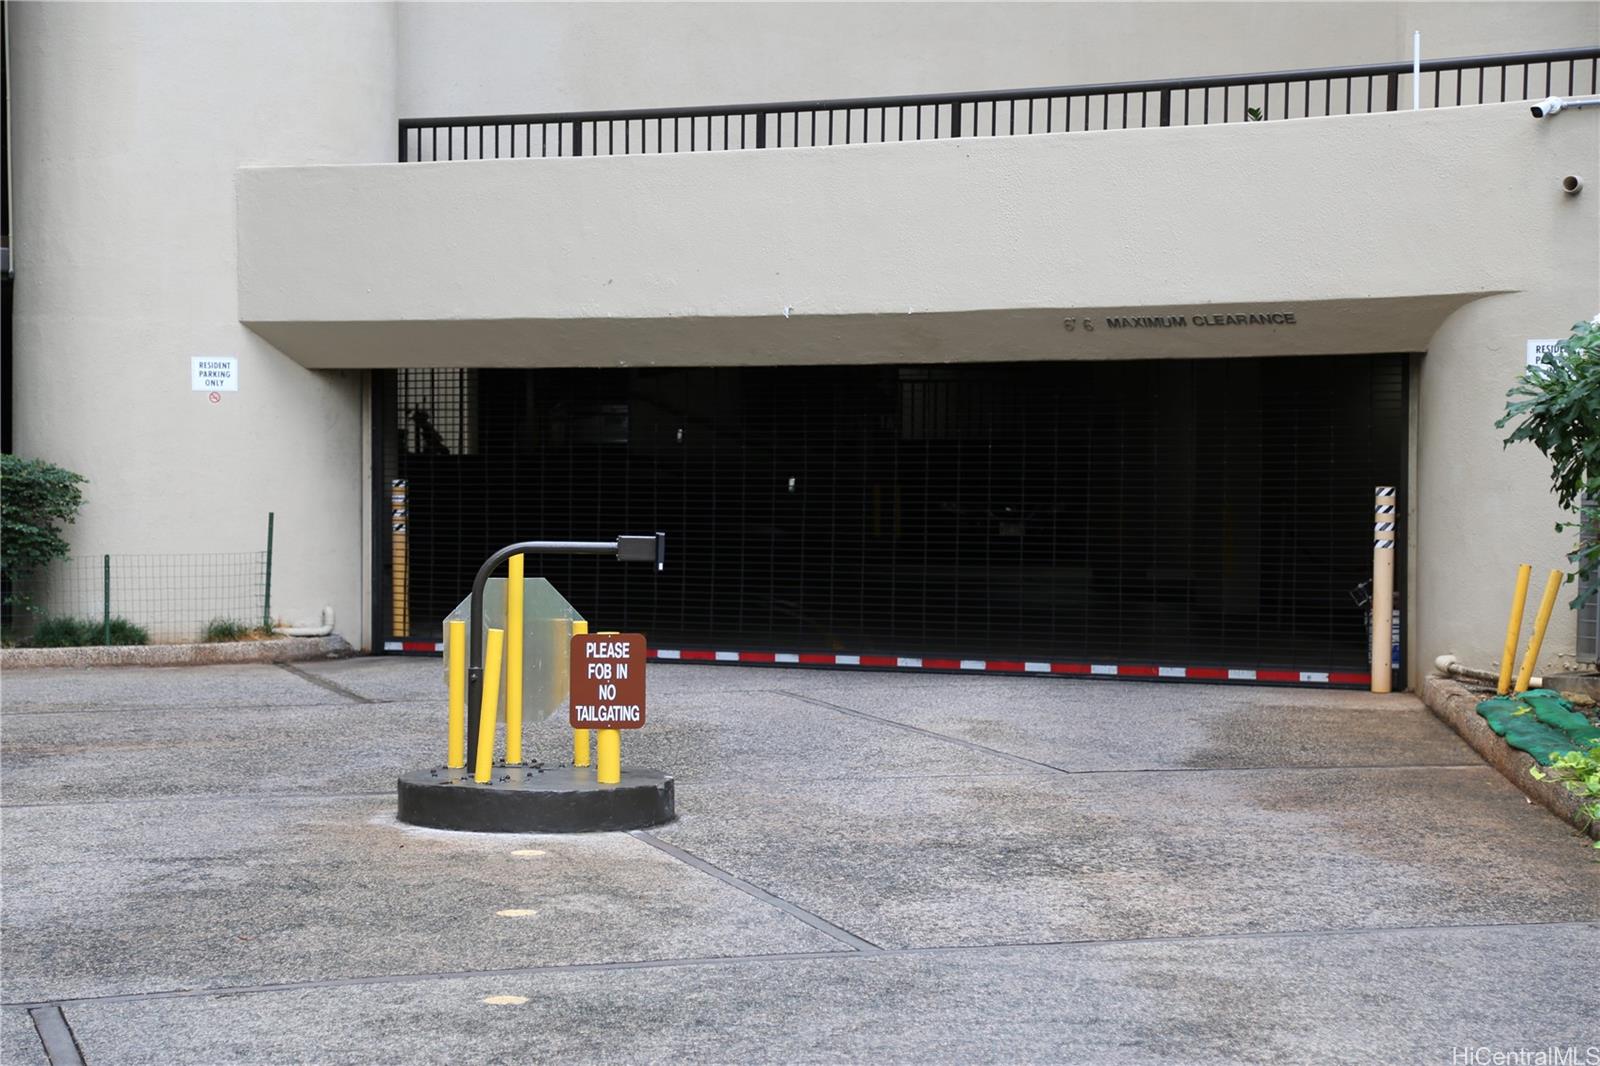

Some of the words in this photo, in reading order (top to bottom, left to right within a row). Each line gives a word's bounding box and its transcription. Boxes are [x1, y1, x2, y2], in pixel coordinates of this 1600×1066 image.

[1105, 316, 1187, 328] MAXIMUM
[1192, 312, 1297, 327] CLEARANCE
[1536, 345, 1564, 354] RESID
[205, 379, 224, 387] ONLY
[586, 642, 630, 658] PLEASE
[588, 663, 612, 679] FOB
[616, 663, 628, 679] IN
[599, 684, 616, 700] NO
[575, 705, 640, 721] TAILGATING
